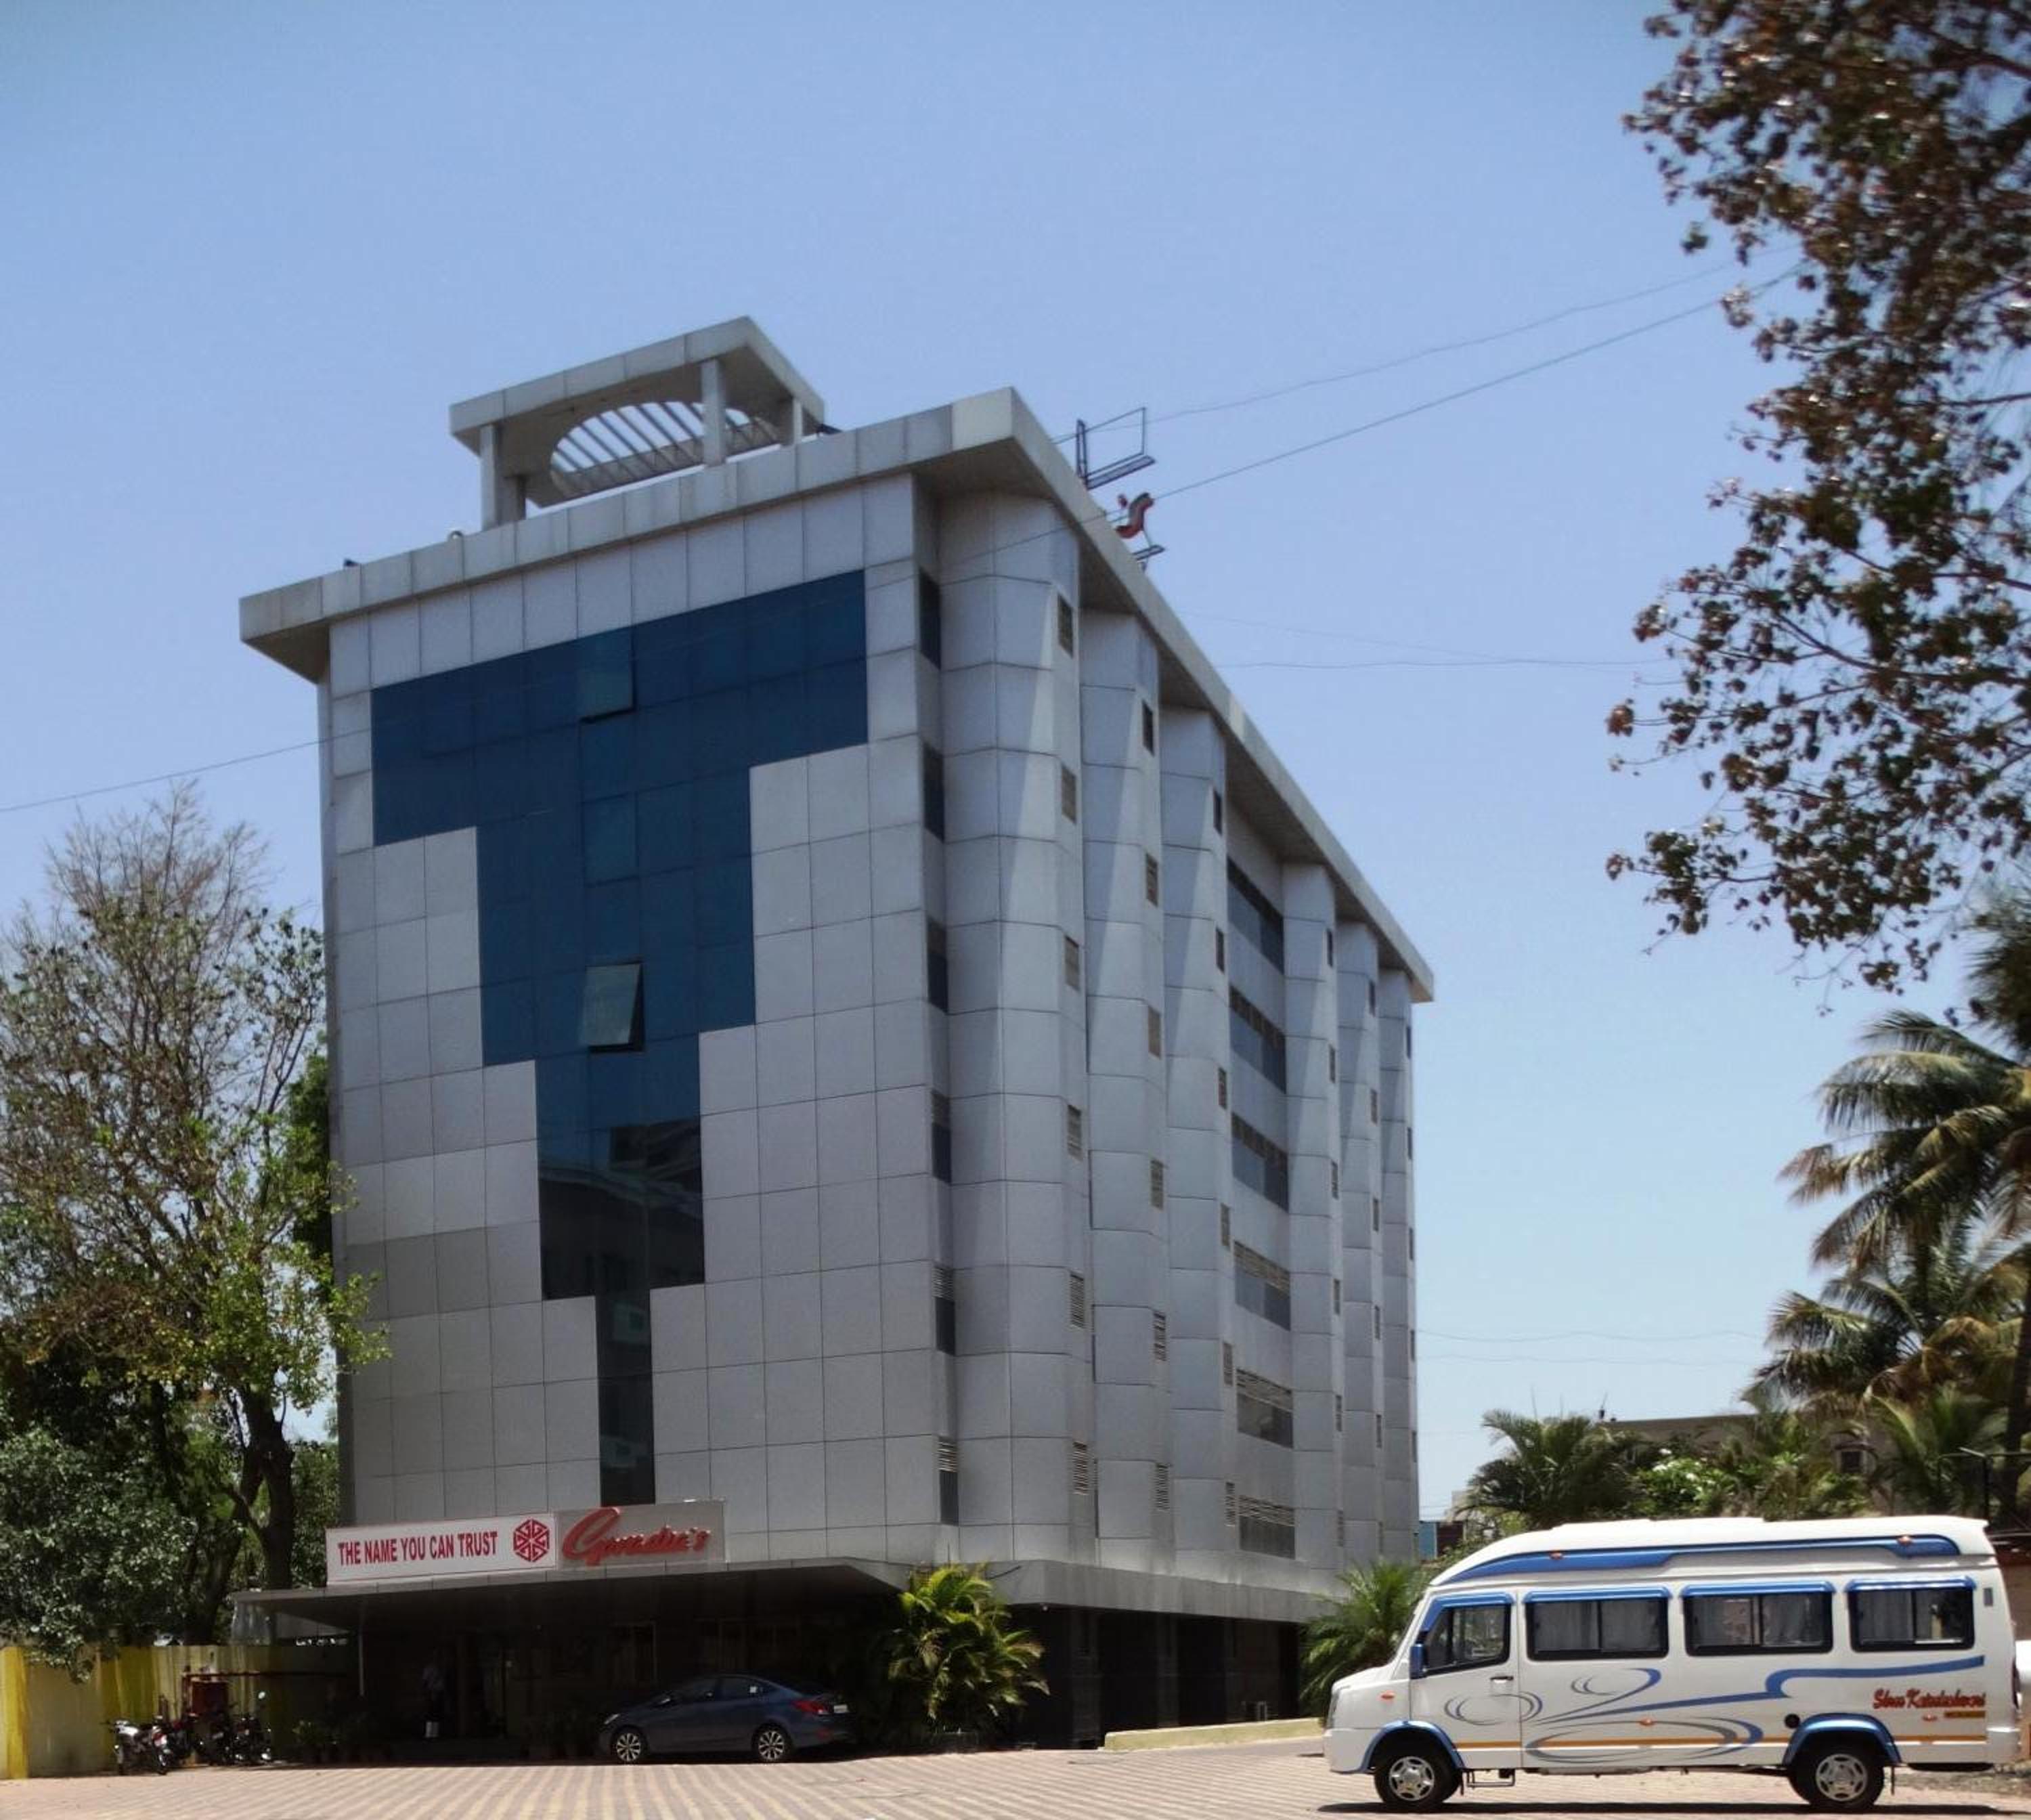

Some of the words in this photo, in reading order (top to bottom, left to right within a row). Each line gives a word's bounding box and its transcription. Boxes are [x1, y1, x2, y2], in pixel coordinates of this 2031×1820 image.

[338, 1542, 361, 1566] THE
[364, 1538, 397, 1565] NAME
[400, 1536, 426, 1561] YOU
[429, 1534, 455, 1559] CAN
[458, 1531, 498, 1557] TRUST
